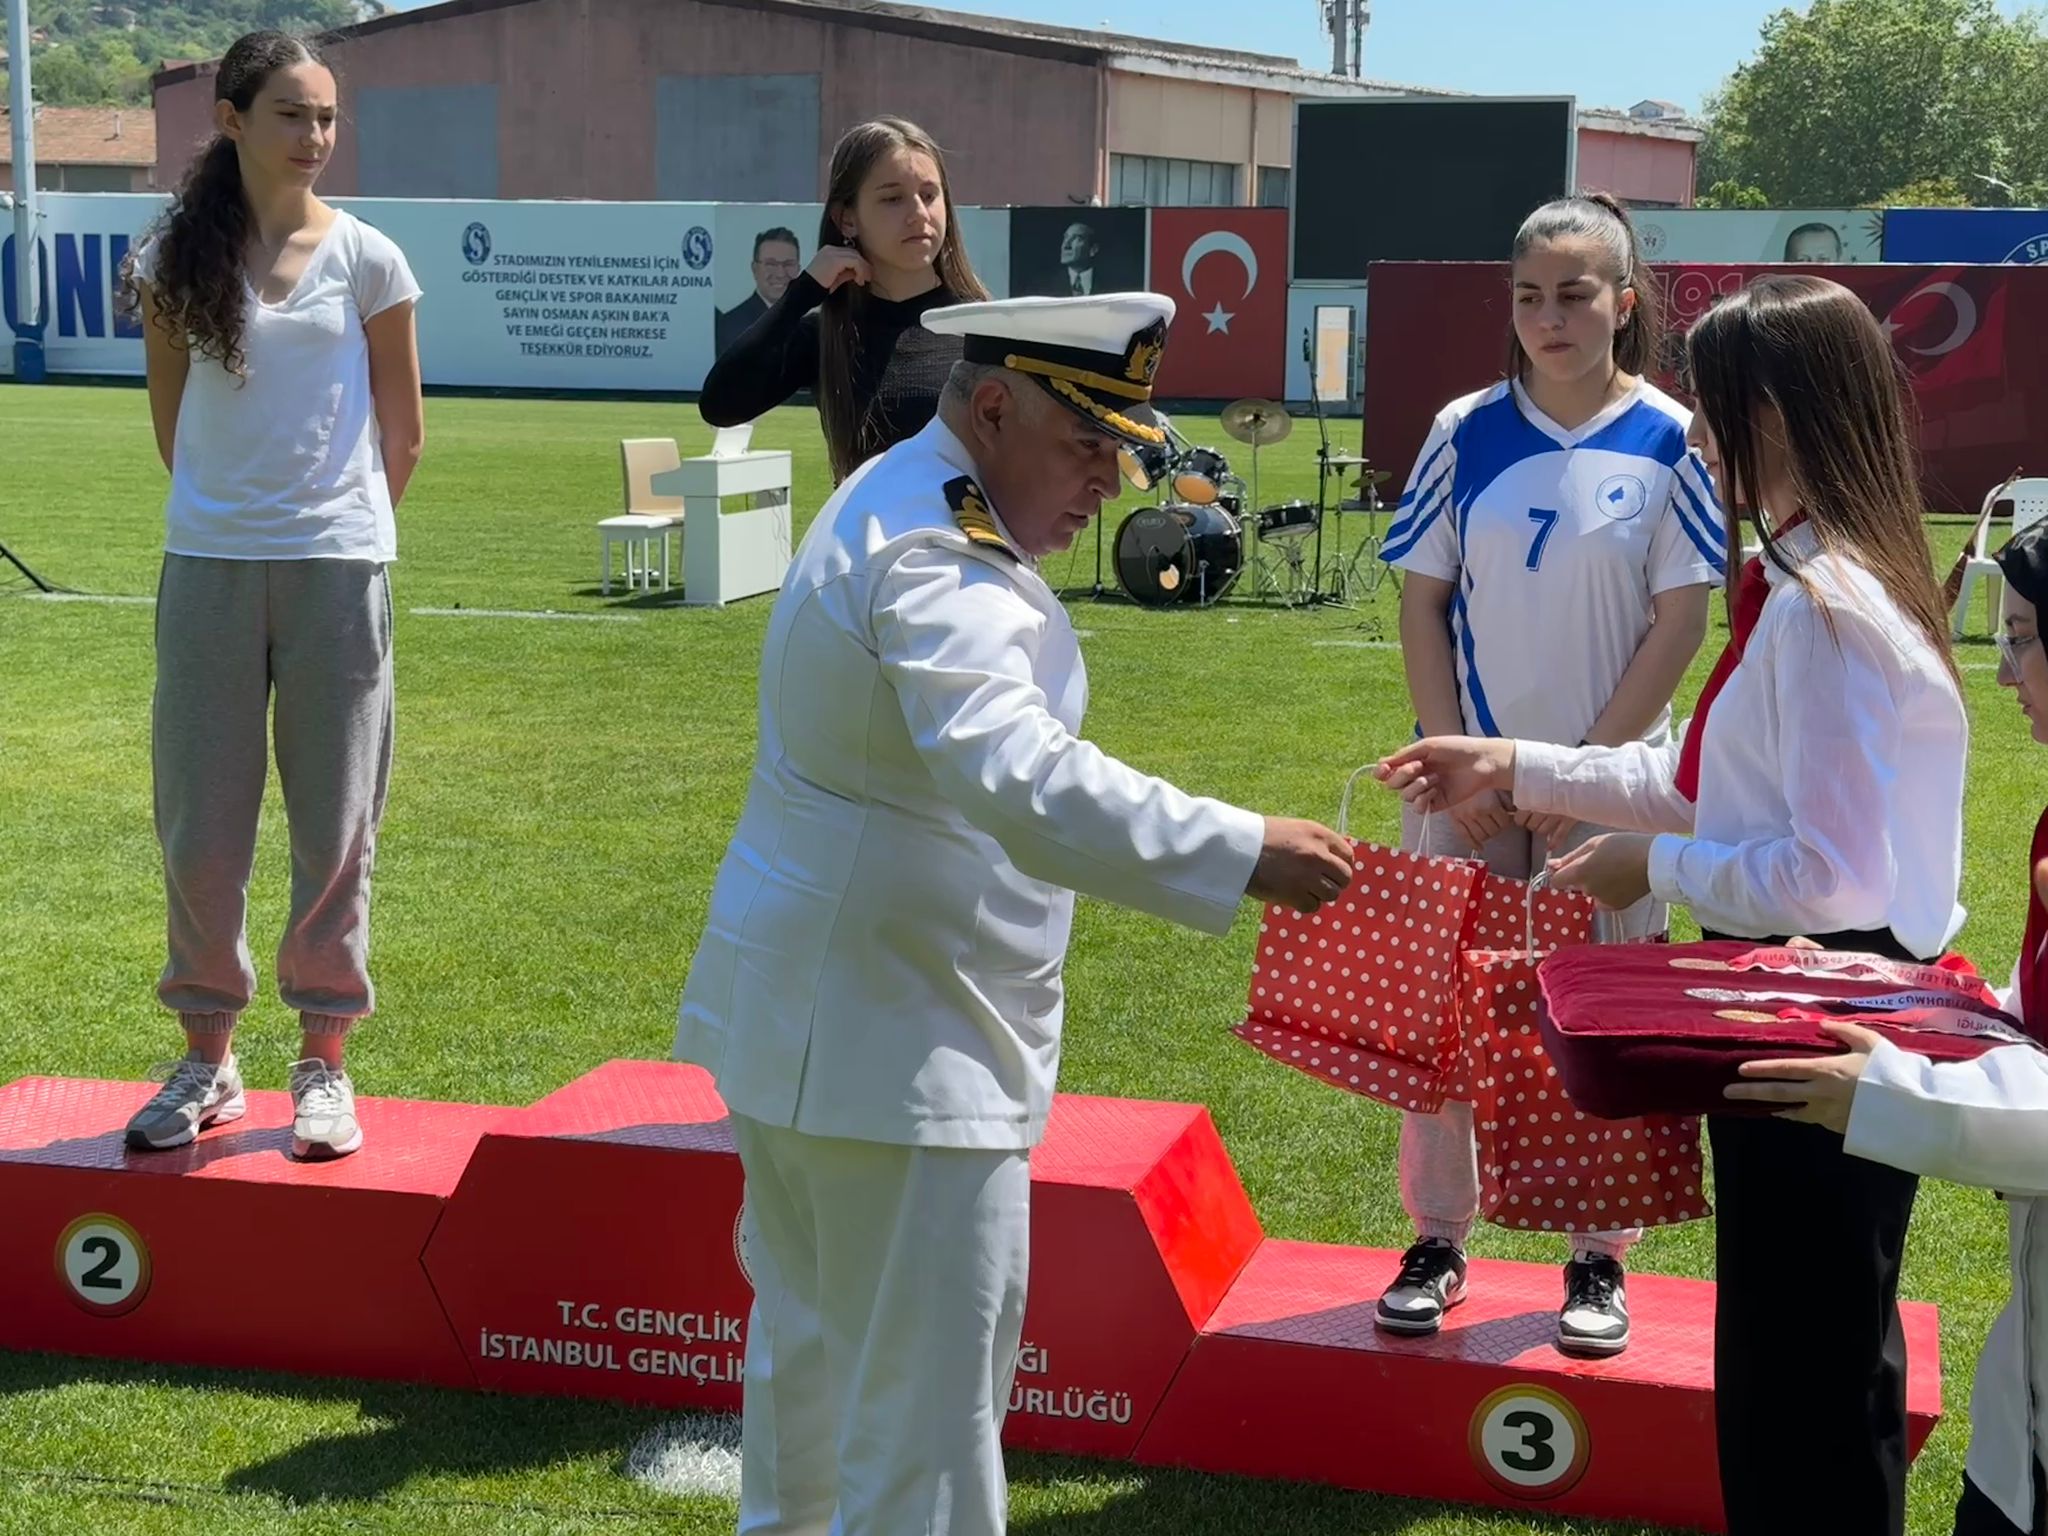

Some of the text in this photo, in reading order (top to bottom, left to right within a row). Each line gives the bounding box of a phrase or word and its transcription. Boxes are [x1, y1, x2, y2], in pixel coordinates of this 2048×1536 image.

[493, 254, 680, 272] STADIMIZIN YENİLENMESİ İÇİN
[462, 269, 713, 288] GÖSTERDİĞİ DESTEK VE KATKILAR ADINA
[495, 288, 678, 305] GENÇLİK VE SPOR BAKANIMIZ
[503, 306, 671, 323] SAYIN OSMAN AŞKIN BAK'A
[506, 323, 667, 341] VE EMEĞİ GEÇEN HERKESE
[520, 341, 653, 357] TEŞEKKÜR EDİYORUZ.
[1526, 507, 1558, 571] 7
[82, 1236, 122, 1289] 2
[557, 1300, 608, 1329] T.C.
[615, 1306, 742, 1344] GENÇLİK
[480, 1327, 621, 1370] İSTANBUL
[1006, 1381, 1132, 1424] ÜRLÜĞÜ
[1501, 1411, 1556, 1472] 3
